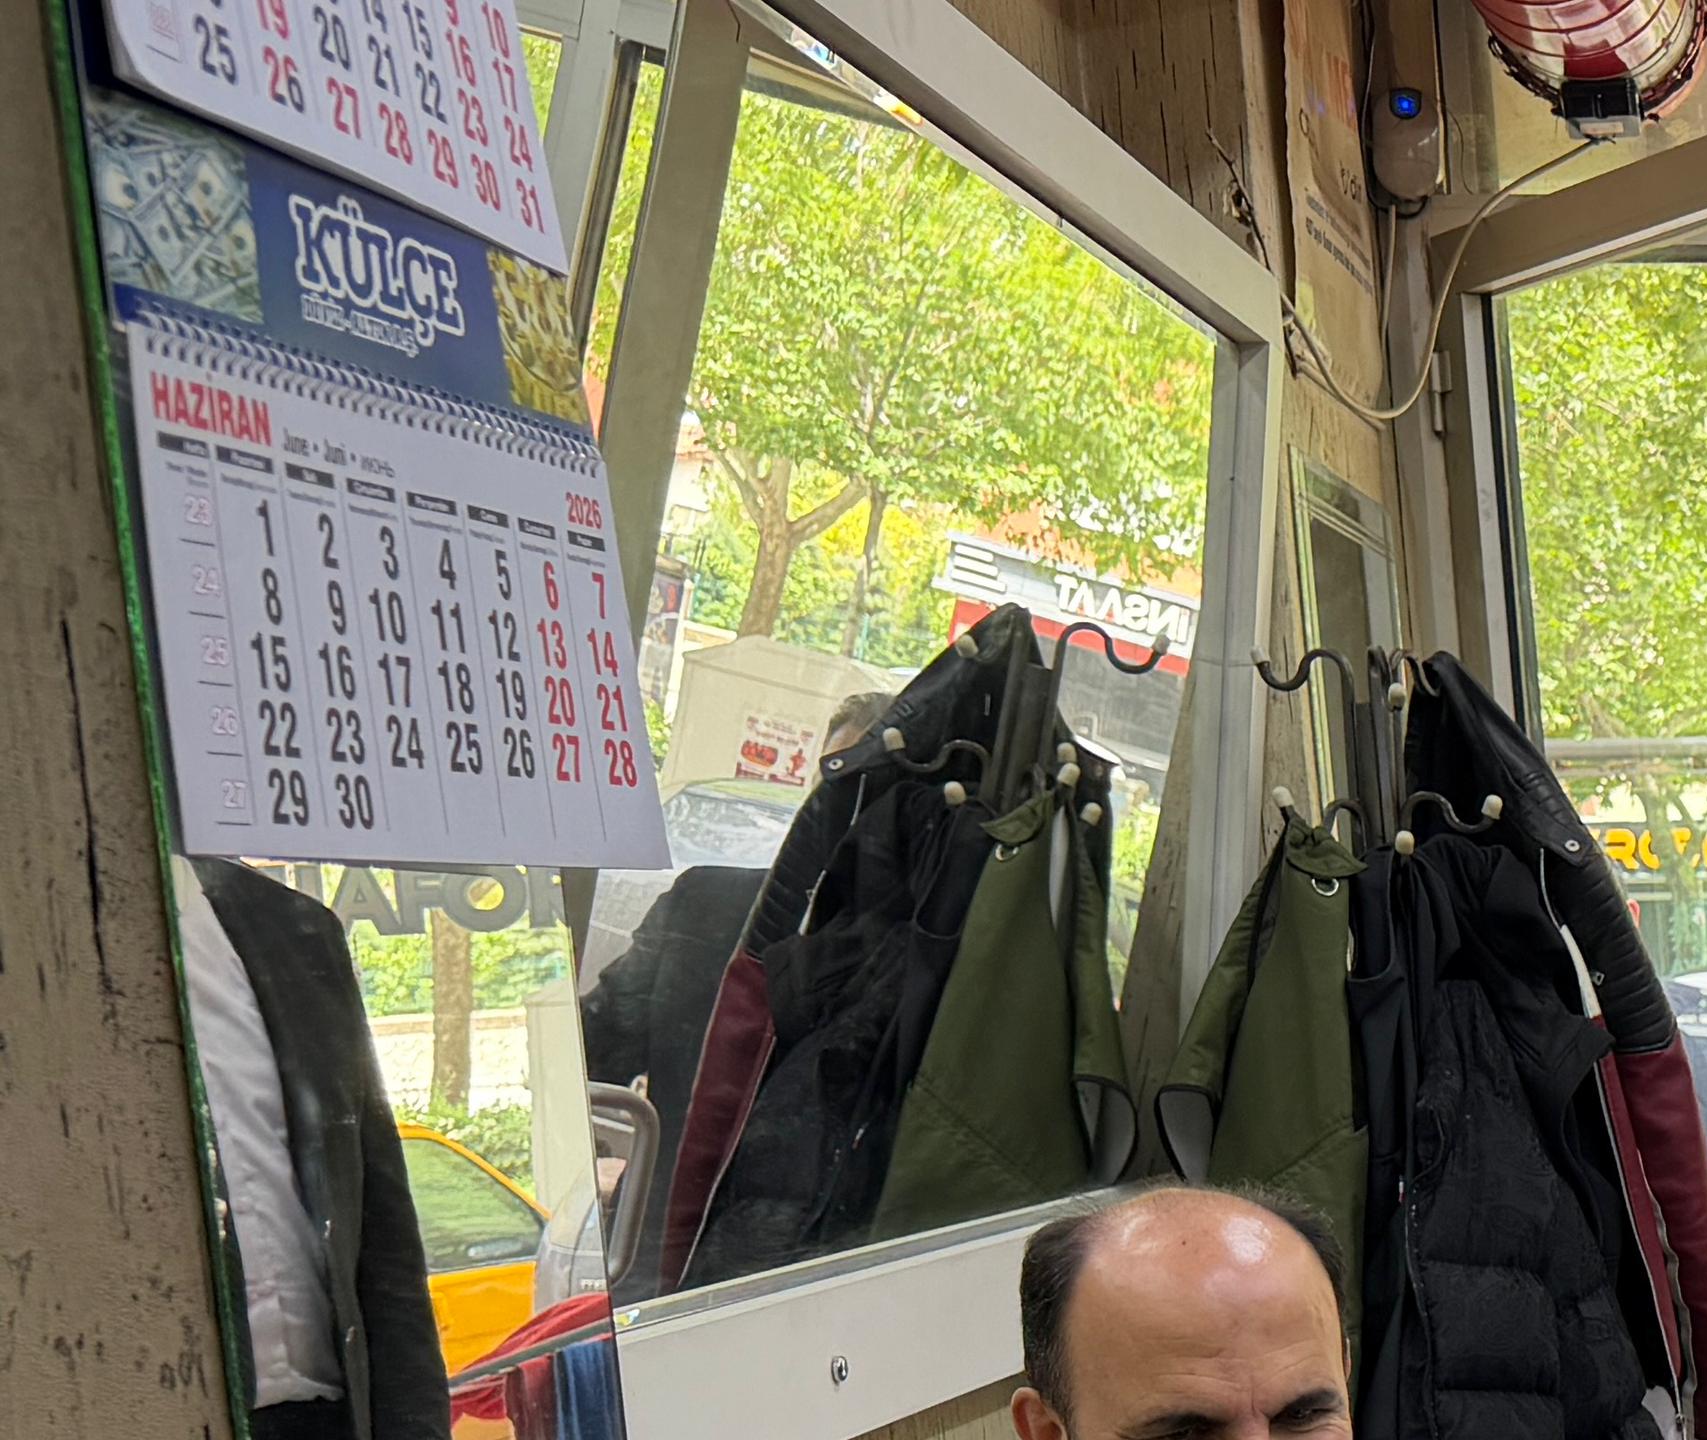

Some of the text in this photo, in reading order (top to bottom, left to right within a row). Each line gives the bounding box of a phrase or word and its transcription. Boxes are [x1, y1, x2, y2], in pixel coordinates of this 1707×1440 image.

[402, 0, 433, 61] 15
[446, 29, 476, 87] 16
[492, 57, 518, 113] 17
[481, 2, 510, 59] 10
[194, 15, 237, 85] 25
[263, 46, 305, 113] 26
[327, 77, 361, 139] 27
[379, 103, 413, 165] 28
[427, 129, 459, 189] 29
[471, 154, 501, 211] 30
[516, 178, 544, 234] 31
[313, 6, 351, 71] 20
[368, 34, 400, 97] 21
[415, 62, 448, 124] 22
[458, 88, 488, 147] 23
[504, 115, 533, 172] 24
[289, 194, 465, 347] KÜLÇE
[151, 371, 274, 447] HAZİRAN
[257, 500, 274, 556] 1
[319, 513, 339, 569] 2
[380, 526, 399, 580] 3
[439, 539, 456, 590] 4
[495, 550, 511, 600] 5
[544, 561, 559, 610] 6
[592, 572, 605, 619] 7
[565, 491, 602, 529] 2026
[262, 568, 282, 625] 8
[328, 581, 346, 635] 9
[369, 588, 406, 645] 10
[431, 600, 465, 654] 11
[488, 610, 520, 662] 12
[537, 618, 567, 669] 13
[587, 628, 618, 677] 14
[251, 632, 291, 692] 15
[318, 643, 356, 700] 16
[378, 653, 411, 708] 17
[438, 661, 474, 714] 18
[496, 668, 527, 720] 19
[545, 676, 575, 727] 20
[597, 684, 627, 732] 21
[259, 700, 301, 758] 22
[327, 708, 365, 765] 23
[387, 715, 424, 769] 24
[446, 722, 482, 774] 25
[504, 727, 535, 779] 26
[553, 733, 580, 782] 27
[605, 739, 637, 787] 28
[269, 768, 309, 826] 29
[335, 774, 374, 829] 30
